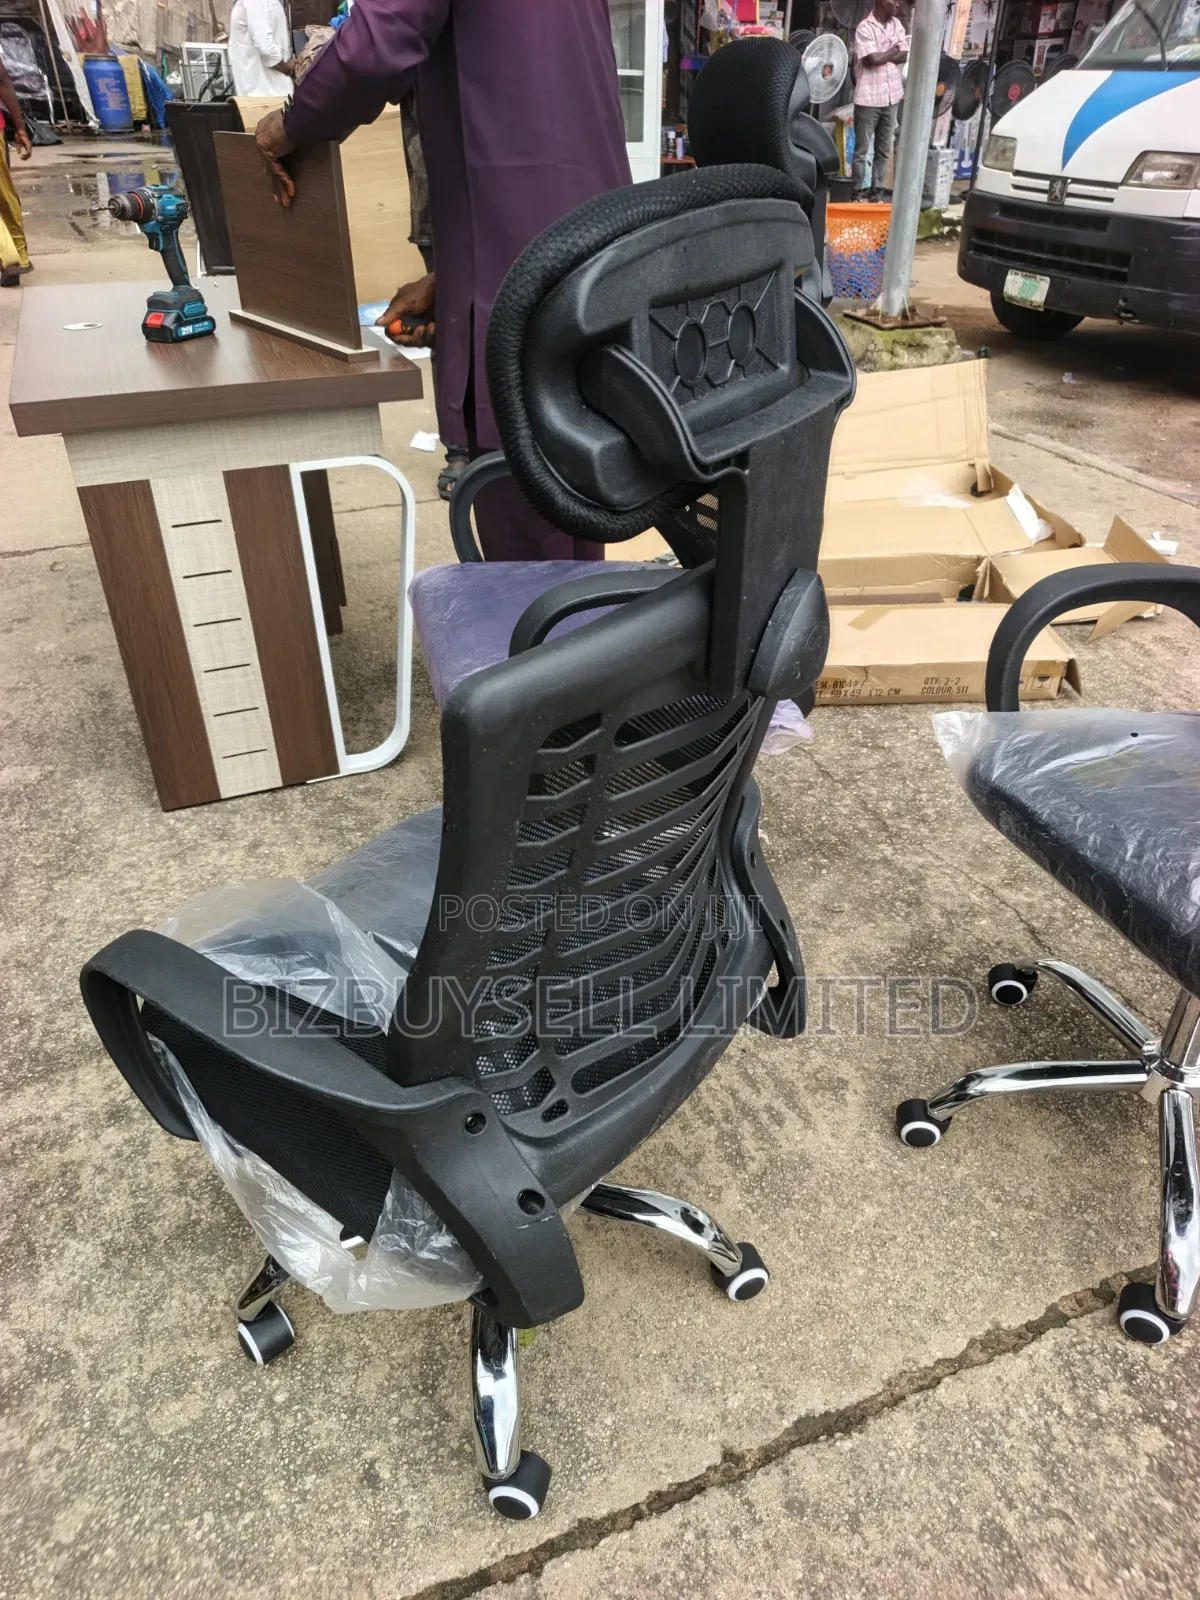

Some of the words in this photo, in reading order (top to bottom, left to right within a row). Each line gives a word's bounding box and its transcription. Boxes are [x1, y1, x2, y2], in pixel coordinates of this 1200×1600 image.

[181, 325, 193, 336] 21V
[815, 680, 830, 690] EM:
[944, 677, 961, 686] 2-2
[887, 688, 901, 696] CM
[955, 686, 969, 694] 511
